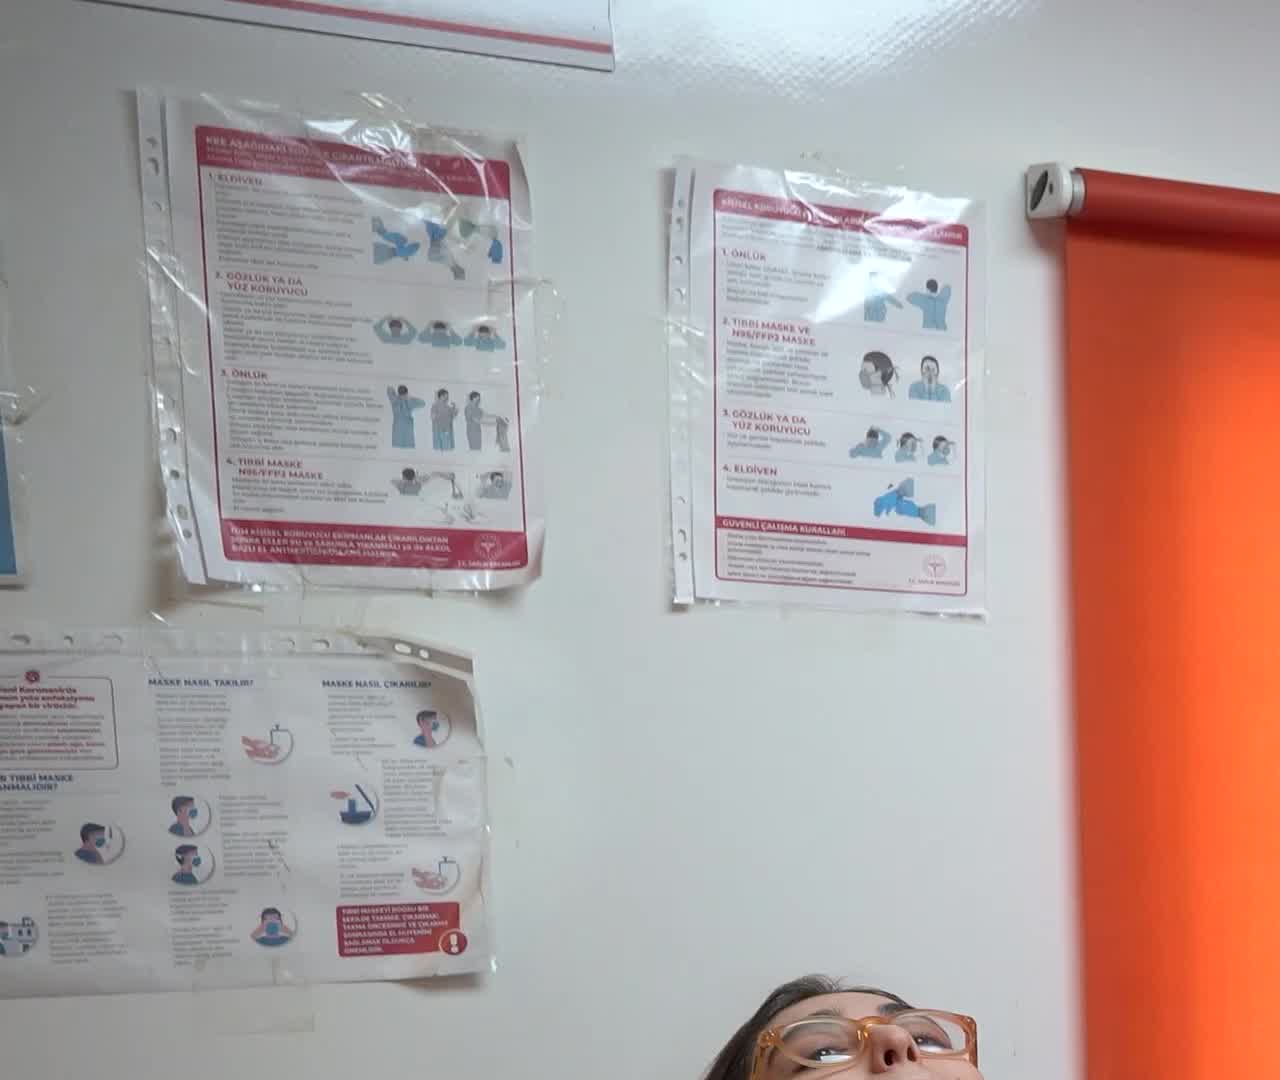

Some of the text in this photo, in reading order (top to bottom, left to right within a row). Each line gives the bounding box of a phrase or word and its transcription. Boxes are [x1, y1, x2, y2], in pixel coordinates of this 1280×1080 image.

[731, 248, 766, 261] ÖNLÜK
[226, 271, 269, 283] GÖZLÜK
[271, 275, 285, 285] YA
[288, 276, 303, 286] DA
[227, 280, 308, 296] YÜZ KORUYUCU
[761, 321, 796, 333] MASKE
[799, 326, 810, 335] VE
[782, 335, 816, 345] MASKE
[232, 369, 268, 380] ÖNLÜK
[732, 409, 774, 421] GÖZLÜK
[776, 415, 789, 423] YA
[792, 416, 807, 424] DA
[732, 419, 810, 436] YÜZ KORUYUCU
[267, 458, 303, 469] MASKE
[288, 470, 324, 480] MASKE
[734, 464, 777, 476] ELDİVEN
[322, 680, 353, 688] MASKE
